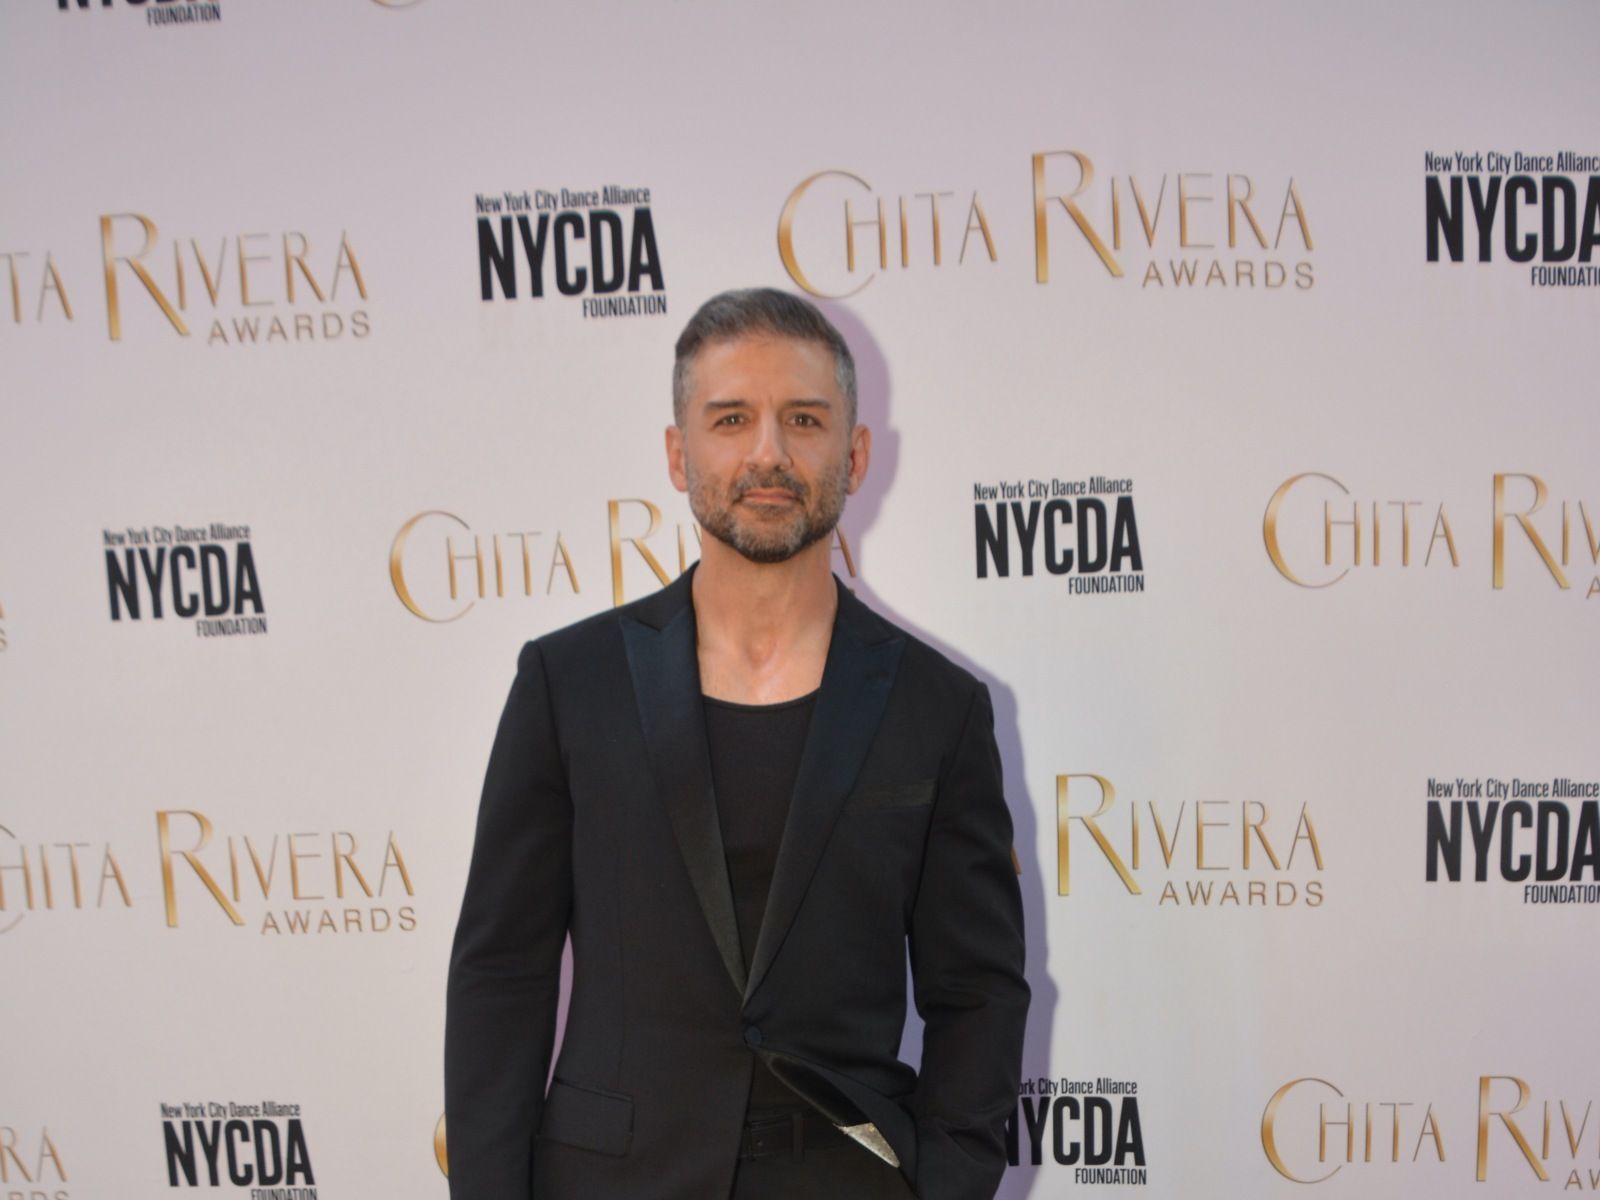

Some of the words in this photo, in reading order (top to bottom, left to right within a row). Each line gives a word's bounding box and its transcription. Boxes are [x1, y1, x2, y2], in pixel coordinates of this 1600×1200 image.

[147, 4, 221, 25] FOUNDATION
[1425, 151, 1452, 172] New
[1455, 151, 1483, 172] York
[1487, 151, 1511, 175] City
[1514, 151, 1553, 172] Dance
[1556, 151, 1600, 172] Allianc
[475, 194, 502, 213] New
[504, 191, 531, 212] York
[535, 190, 559, 211] City
[561, 188, 599, 208] Dance
[602, 185, 650, 206] Alliance
[778, 170, 998, 299] CHITA
[1032, 149, 1314, 284] RIVERA
[477, 207, 665, 301] NYCDA
[99, 213, 368, 342] RIVERA
[1142, 259, 1315, 290] AWARDS
[1531, 266, 1600, 286] FOUNDATI
[583, 295, 667, 318] FOUNDATION
[208, 310, 371, 346] AWARDS
[974, 482, 998, 500] New
[1000, 481, 1024, 499] York
[1028, 479, 1049, 500] City
[1052, 478, 1086, 496] Dance
[1089, 476, 1133, 494] Alliance
[103, 529, 125, 546] New
[127, 528, 150, 545] York
[153, 526, 172, 544] City
[175, 525, 206, 542] Dance
[209, 523, 250, 541] Alliance
[974, 495, 1143, 579] NYCDA
[1263, 472, 1460, 589] CHITA
[1492, 472, 1600, 590] RIV
[105, 541, 265, 621] NYCDA
[390, 510, 580, 624] CHITA
[1068, 575, 1145, 595] FOUNDATION
[196, 617, 267, 637] FOUNDATION
[1427, 778, 1453, 798] New
[1455, 778, 1482, 798] York
[1486, 778, 1509, 800] City
[1512, 778, 1549, 798] Dance
[1552, 778, 1599, 798] Alliance
[1056, 773, 1324, 897] RIVERA
[1425, 800, 1600, 882] NYCDA
[156, 809, 415, 929] RIVERA
[1158, 880, 1325, 907] AWARDS
[1524, 885, 1600, 904] FOUNDATIO
[260, 906, 418, 935] AWARDS
[1038, 1078, 1059, 1096] City
[1061, 1077, 1094, 1094] Dance
[1096, 1077, 1138, 1094] Alliance
[160, 1102, 182, 1118] New
[184, 1102, 206, 1118] York
[208, 1101, 228, 1119] City
[229, 1101, 260, 1117] Dance
[262, 1100, 300, 1117] Alliance
[1261, 1077, 1446, 1184] CHITA
[1476, 1075, 1600, 1183] RIV
[163, 1118, 315, 1187] NYCDA
[1075, 1167, 1147, 1185] FOUNDATION
